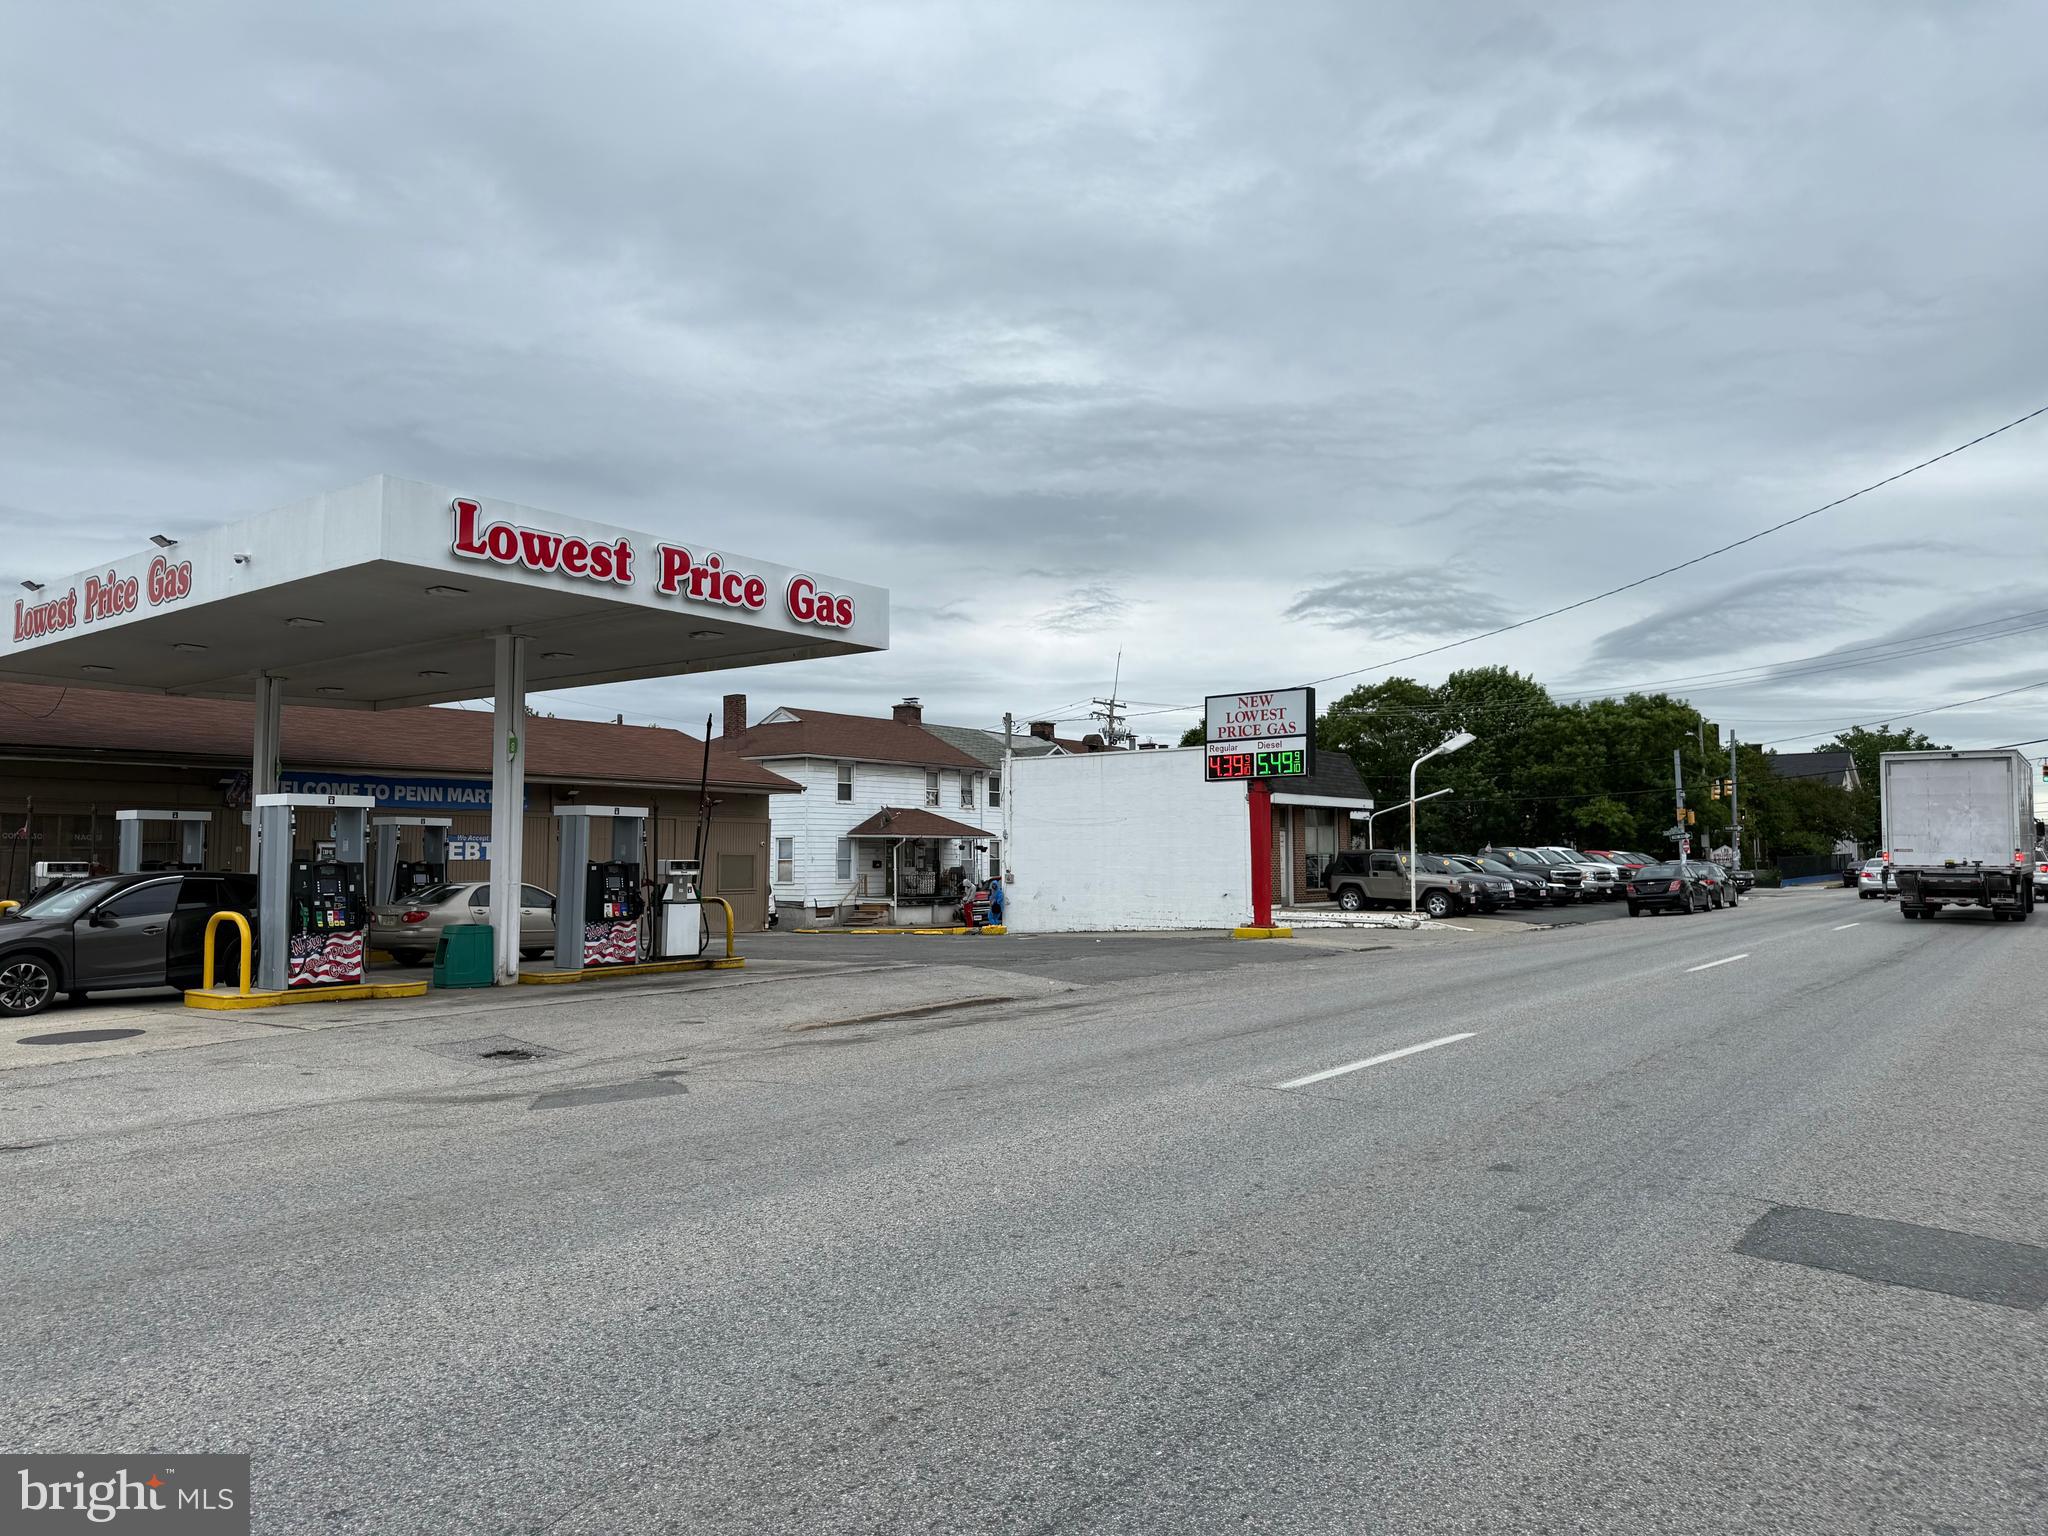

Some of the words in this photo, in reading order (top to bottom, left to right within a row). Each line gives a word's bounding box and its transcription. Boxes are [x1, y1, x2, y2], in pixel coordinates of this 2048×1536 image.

[454, 499, 633, 583] Lowest
[659, 545, 766, 609] Price
[787, 576, 853, 627] Gas
[13, 589, 76, 641] Lowest
[84, 571, 138, 621] Price
[147, 557, 191, 605] Gas
[1238, 694, 1274, 709] NEW
[1226, 708, 1287, 724] LOWEST
[1217, 724, 1262, 739] PRICE
[1267, 721, 1297, 735] GAS
[1209, 743, 1238, 754] Regular
[1257, 740, 1282, 750] Diesel
[277, 781, 360, 795] ELCOME
[363, 784, 390, 800] TO
[394, 785, 443, 802] PENN
[449, 841, 493, 860] EBT
